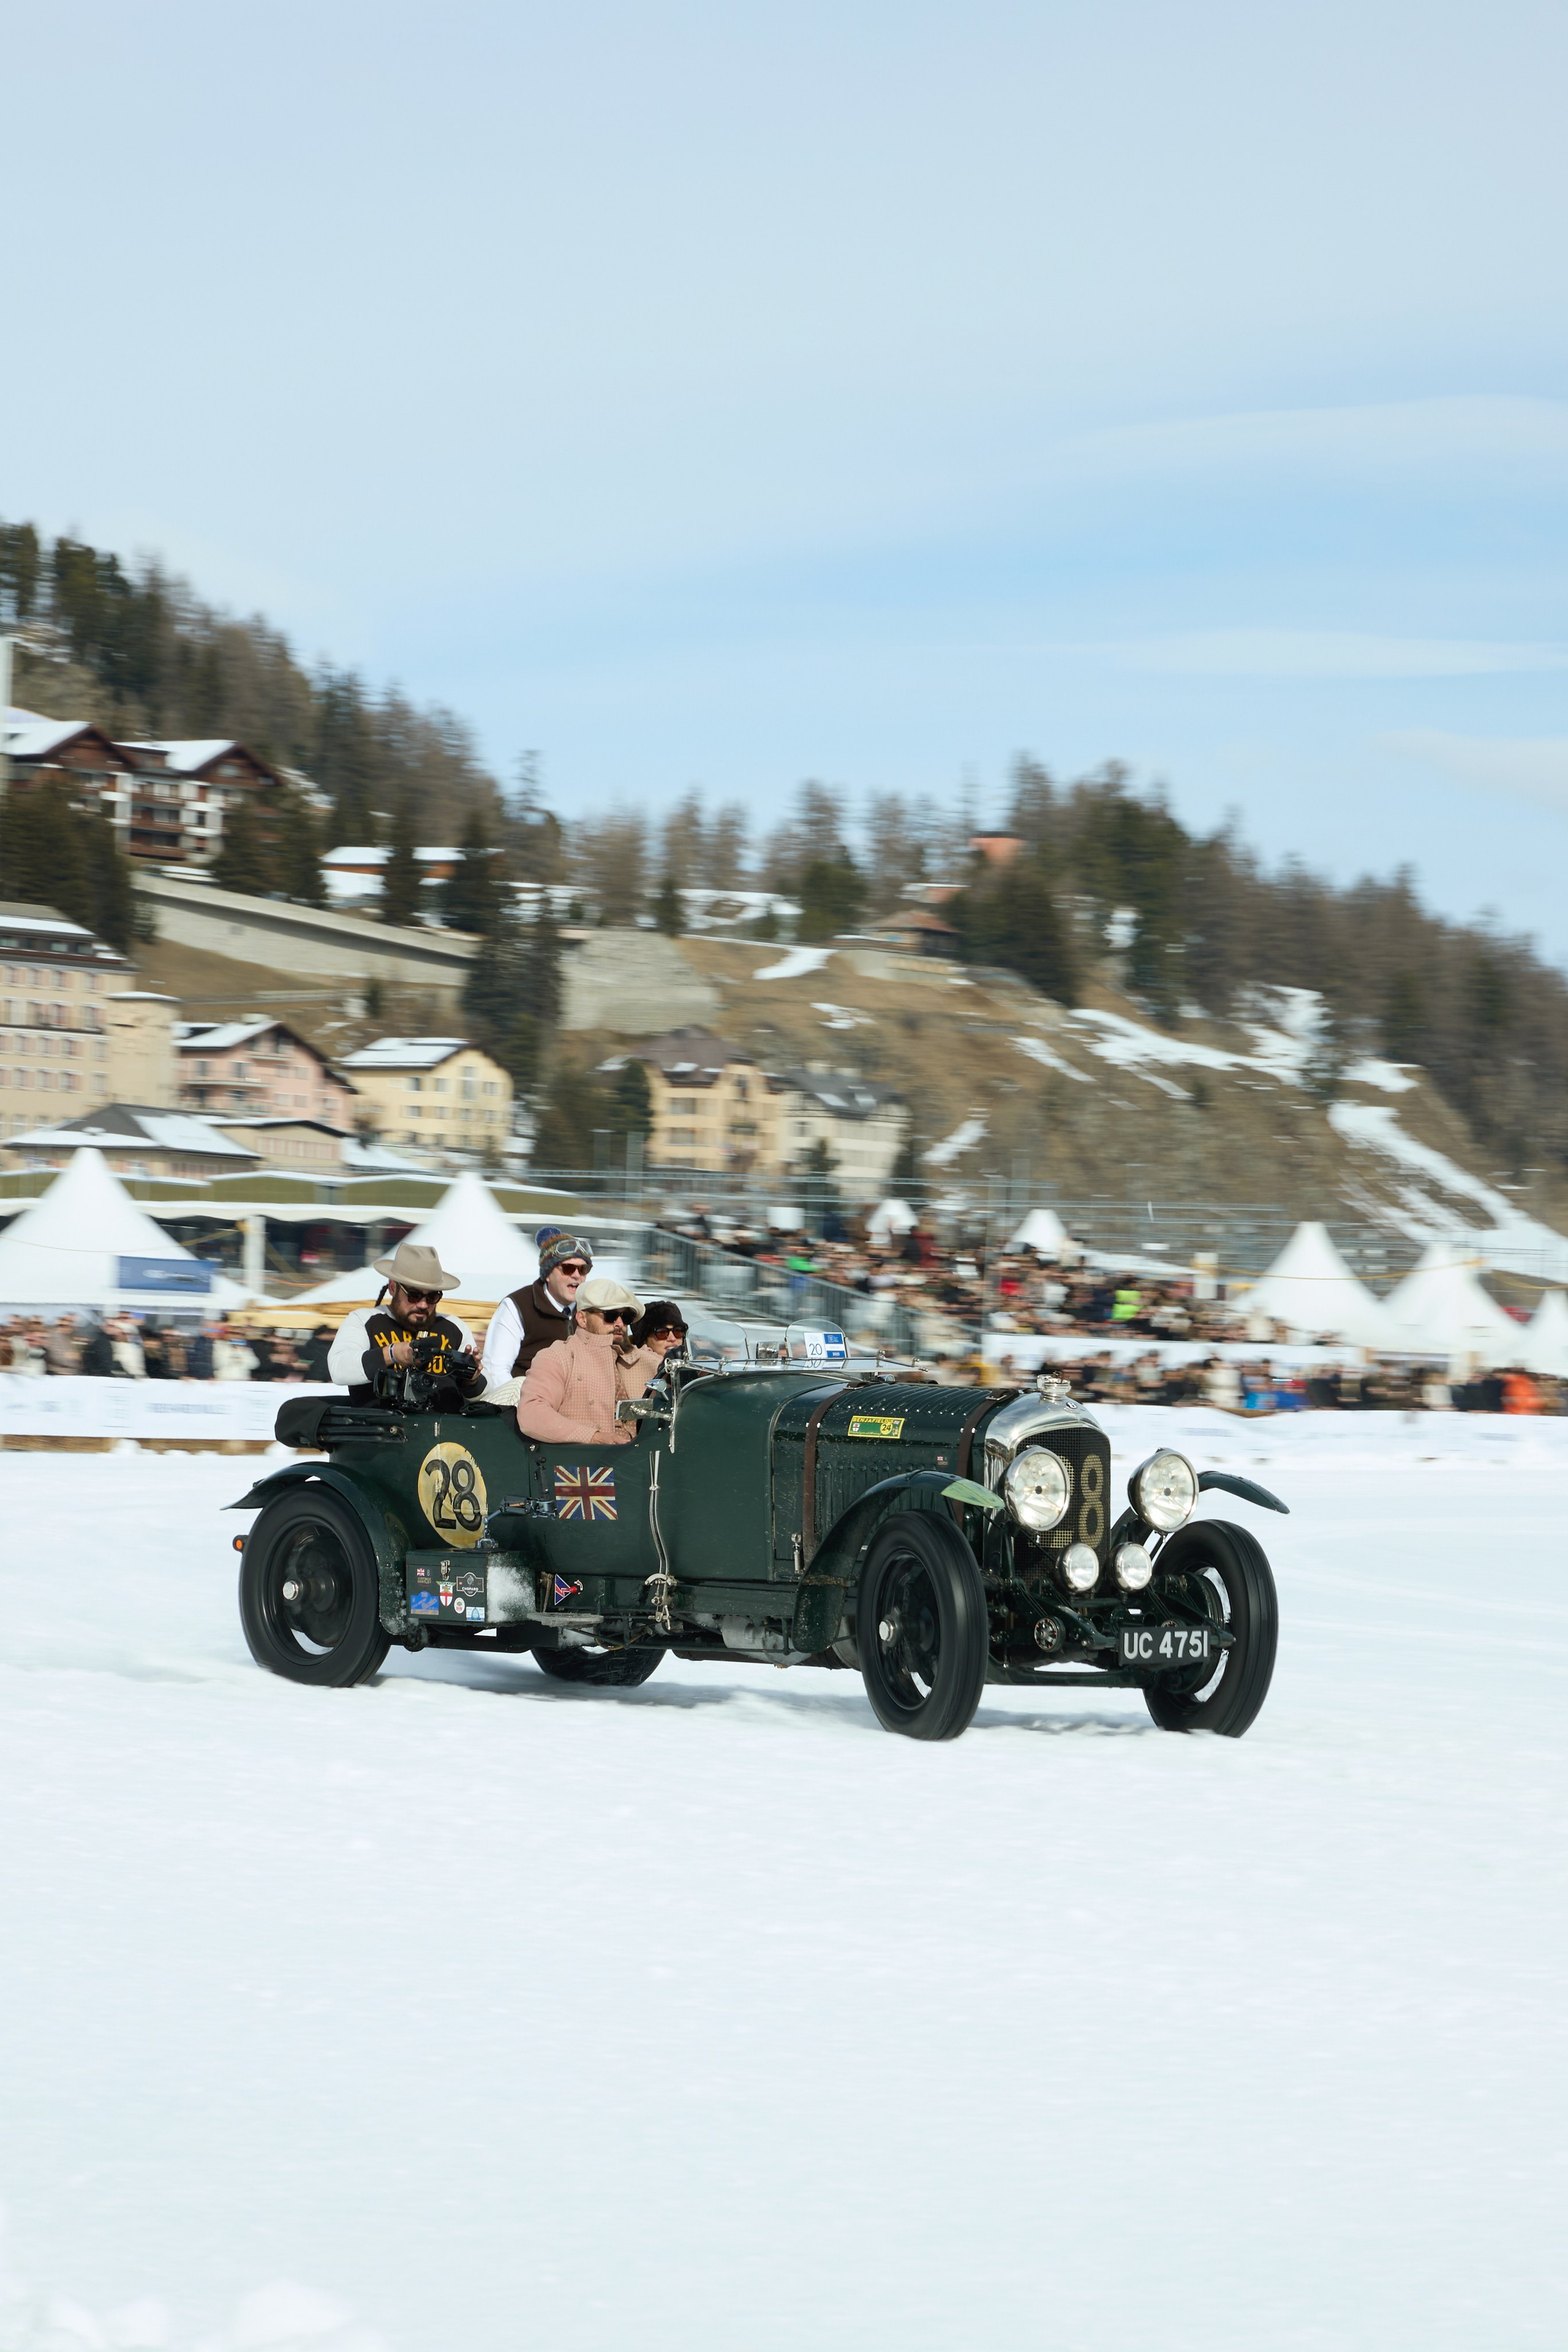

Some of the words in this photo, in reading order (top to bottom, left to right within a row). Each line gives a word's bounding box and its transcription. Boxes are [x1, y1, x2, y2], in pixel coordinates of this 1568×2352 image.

[809, 1343, 823, 1355] 20
[425, 1458, 482, 1532] 28
[1124, 1632, 1153, 1660] UC
[1159, 1630, 1208, 1659] 4751
